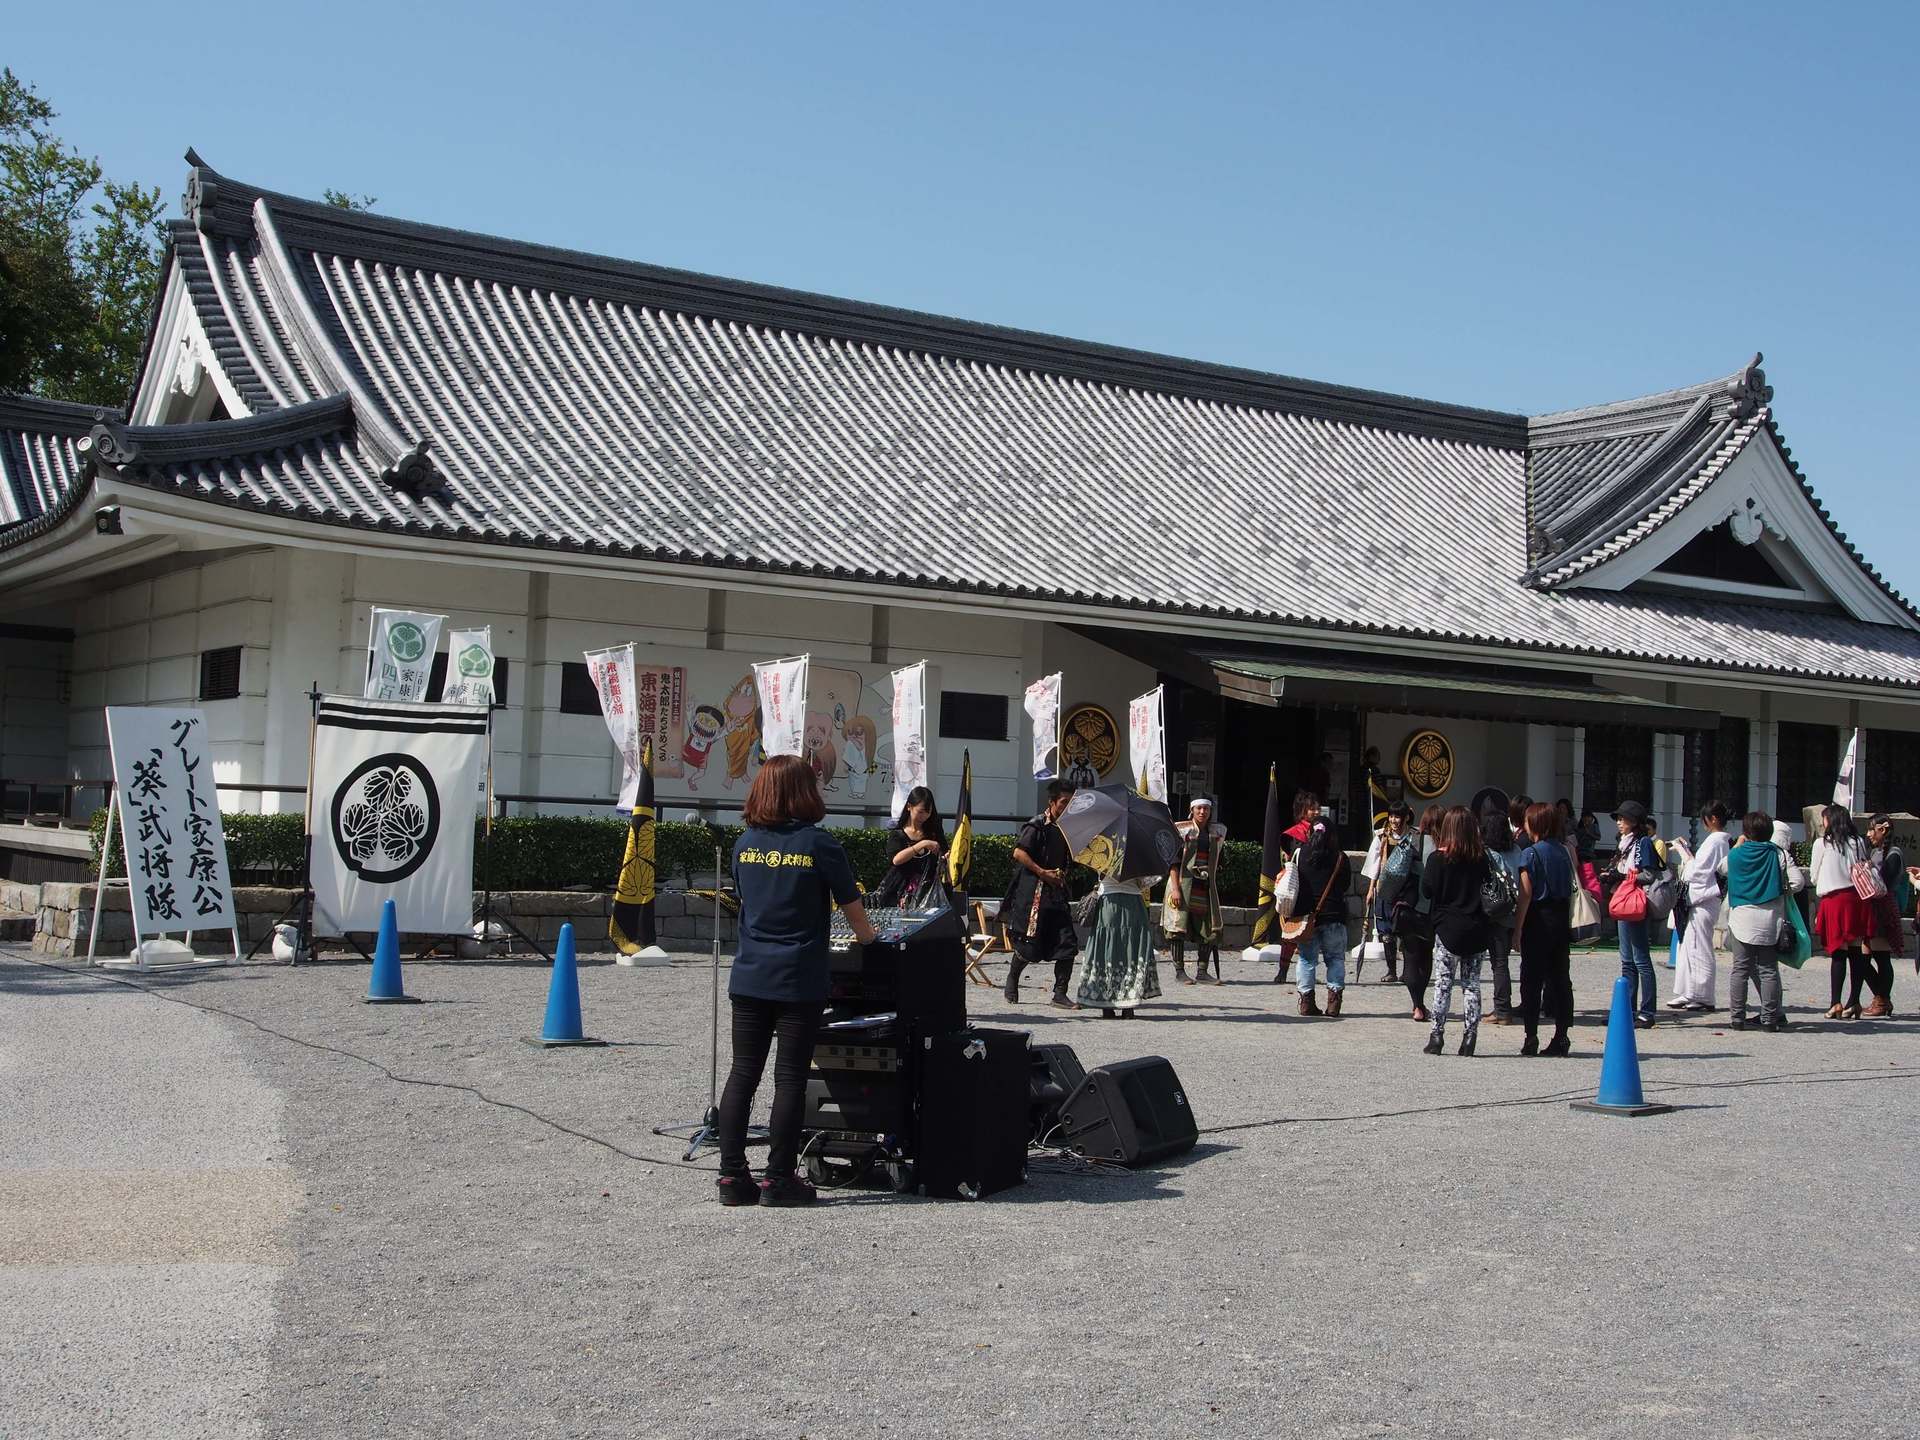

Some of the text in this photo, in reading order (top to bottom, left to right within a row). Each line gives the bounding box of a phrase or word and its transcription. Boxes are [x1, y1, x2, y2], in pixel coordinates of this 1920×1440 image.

[399, 668, 415, 701] 家康
[170, 718, 223, 916] グレート家康公
